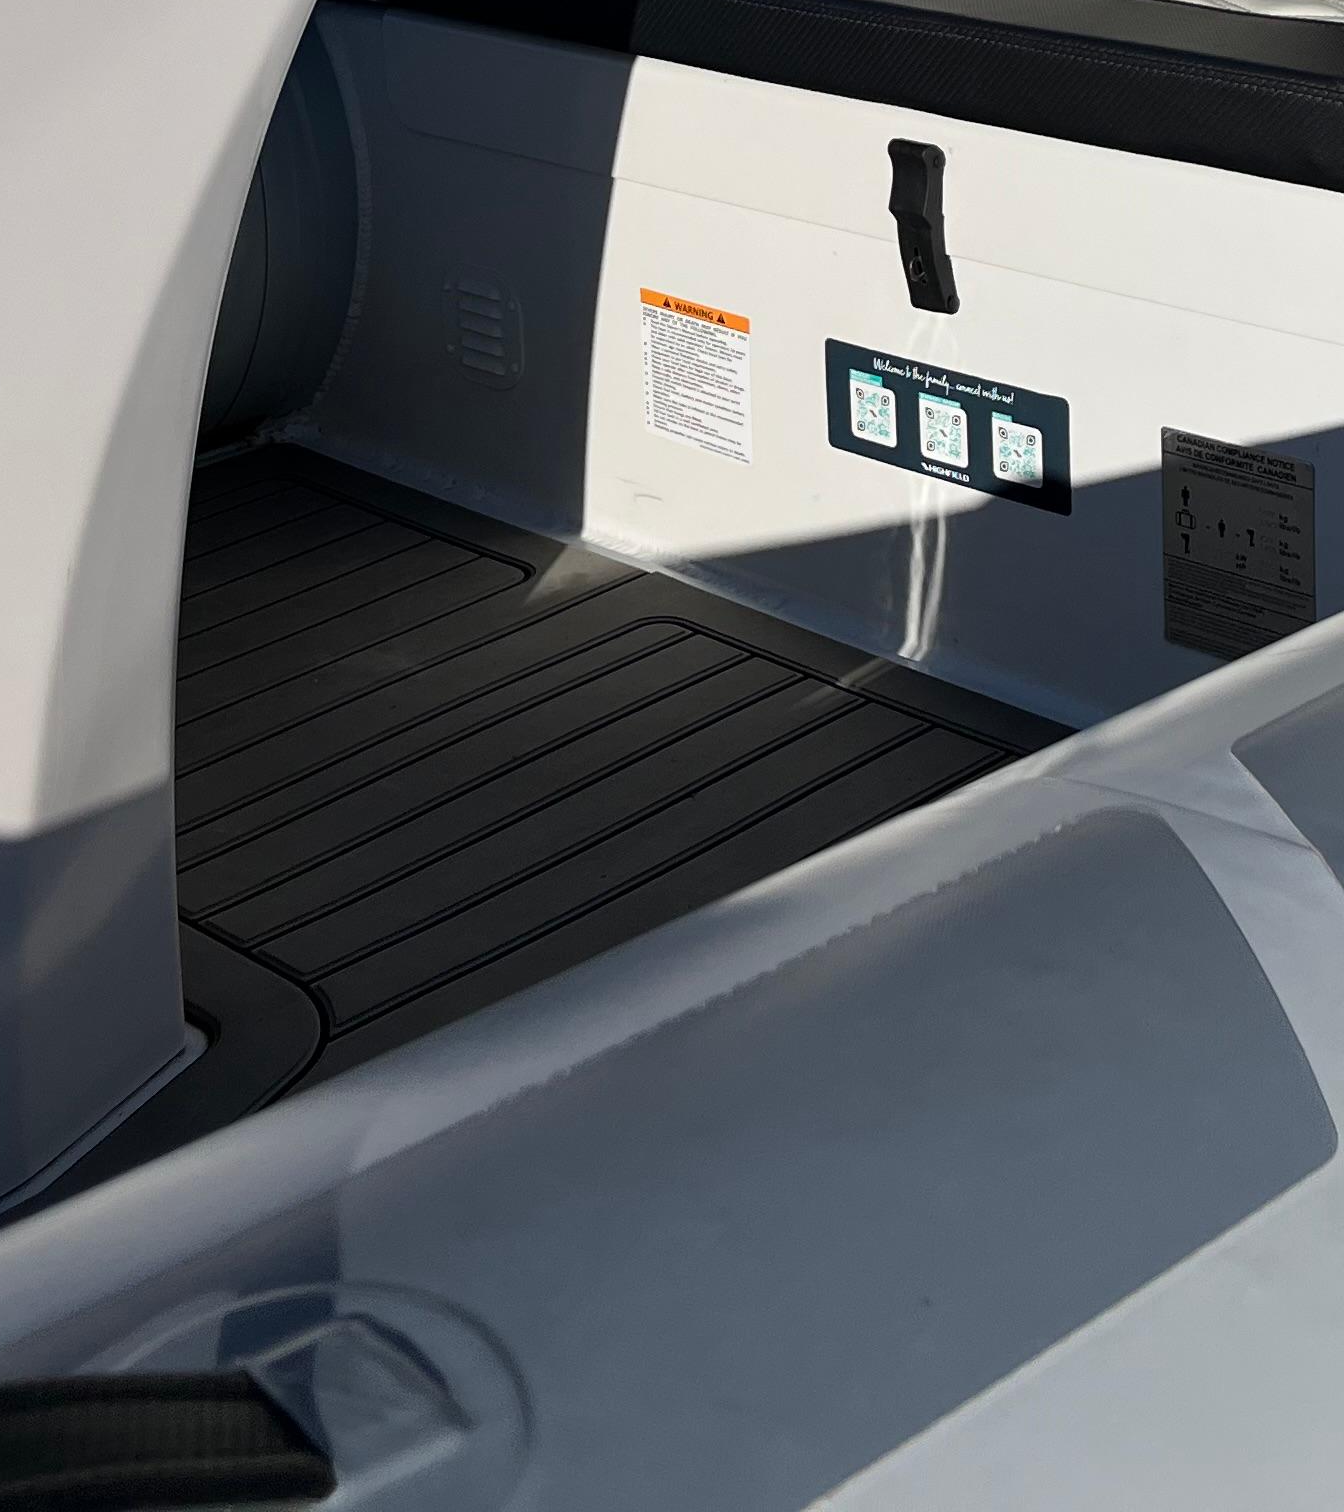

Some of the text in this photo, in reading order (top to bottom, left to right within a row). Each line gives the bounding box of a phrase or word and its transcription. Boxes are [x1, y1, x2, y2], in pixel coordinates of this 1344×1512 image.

[674, 301, 714, 320] WARNING
[873, 357, 905, 377] Welcome
[905, 365, 912, 379] to
[912, 366, 925, 382] the
[981, 386, 1002, 401] with
[1176, 434, 1296, 472] CANADIAN COMPLIANCE NOTICE
[1176, 445, 1192, 456] AVIS
[1194, 448, 1204, 459] DE
[1257, 465, 1297, 482] CANADIEN
[928, 464, 970, 483] HIGHFIELD
